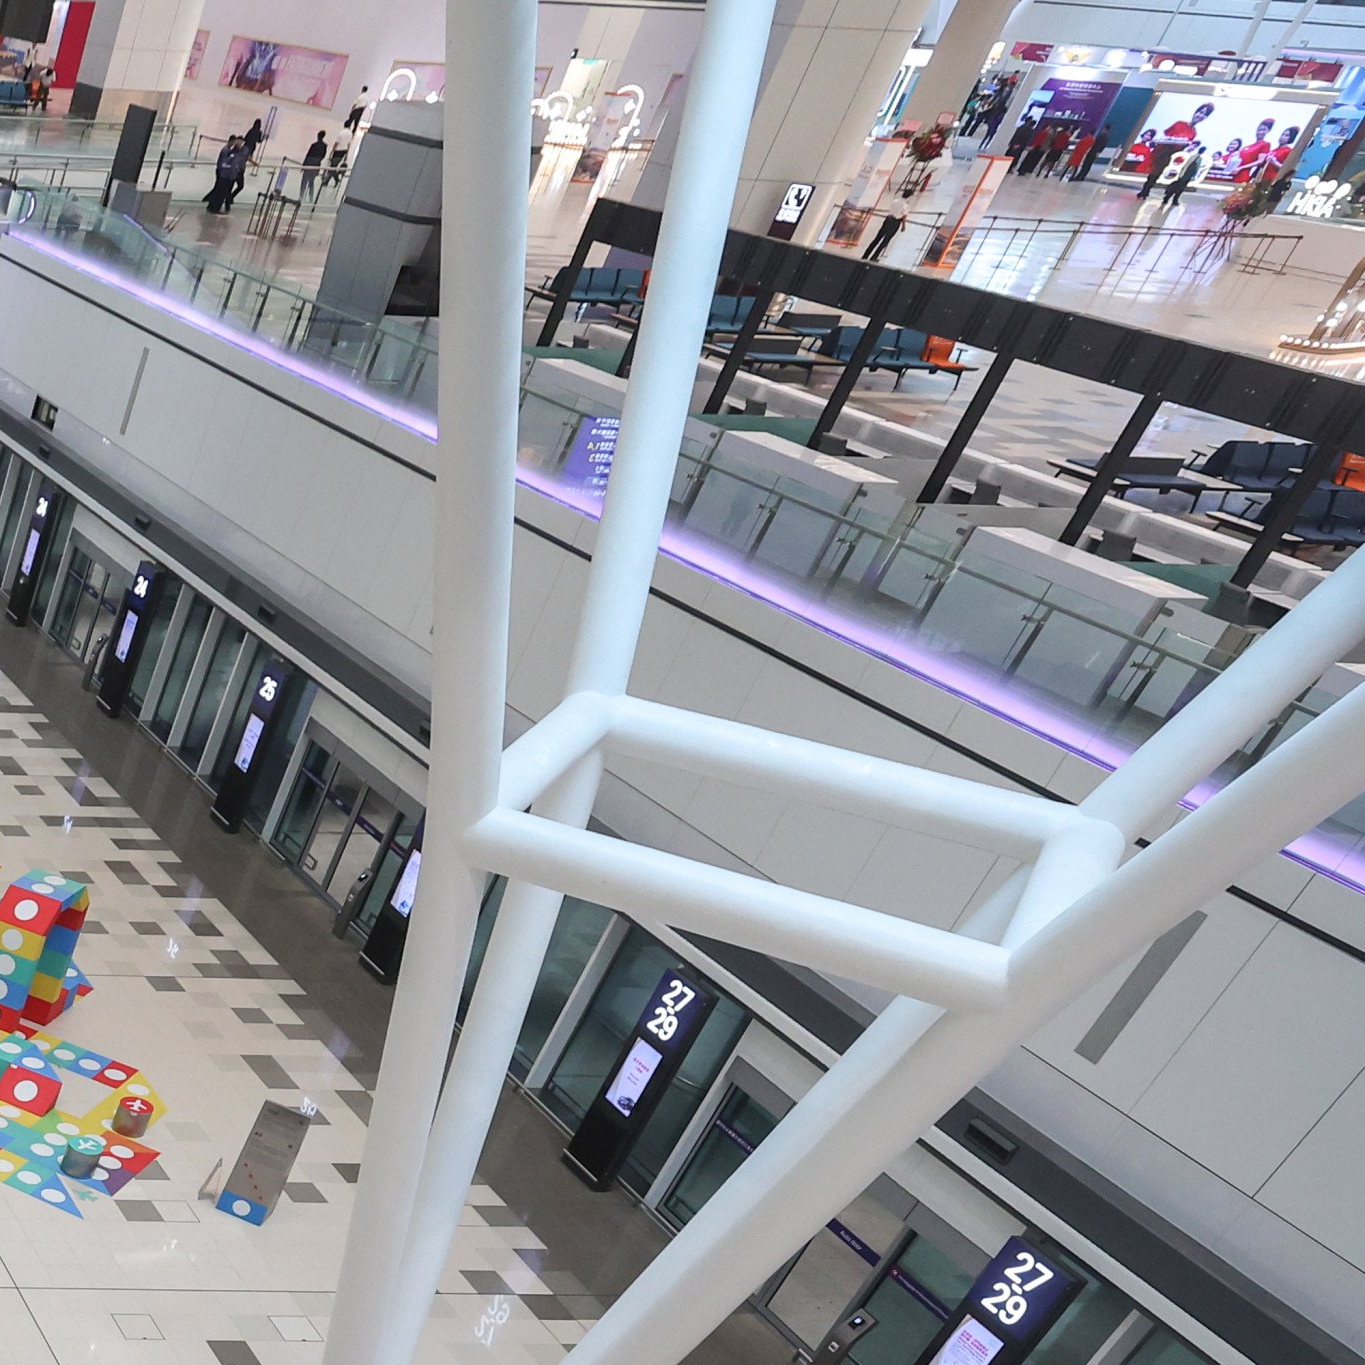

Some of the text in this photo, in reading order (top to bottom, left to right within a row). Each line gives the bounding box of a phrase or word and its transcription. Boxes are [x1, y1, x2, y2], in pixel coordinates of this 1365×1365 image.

[36, 497, 48, 517] 24
[134, 575, 149, 598] 24
[259, 676, 278, 702] 25
[662, 979, 696, 1012] 27
[646, 1007, 679, 1041] 29
[1003, 1252, 1054, 1292] 27
[980, 1282, 1028, 1325] 29
